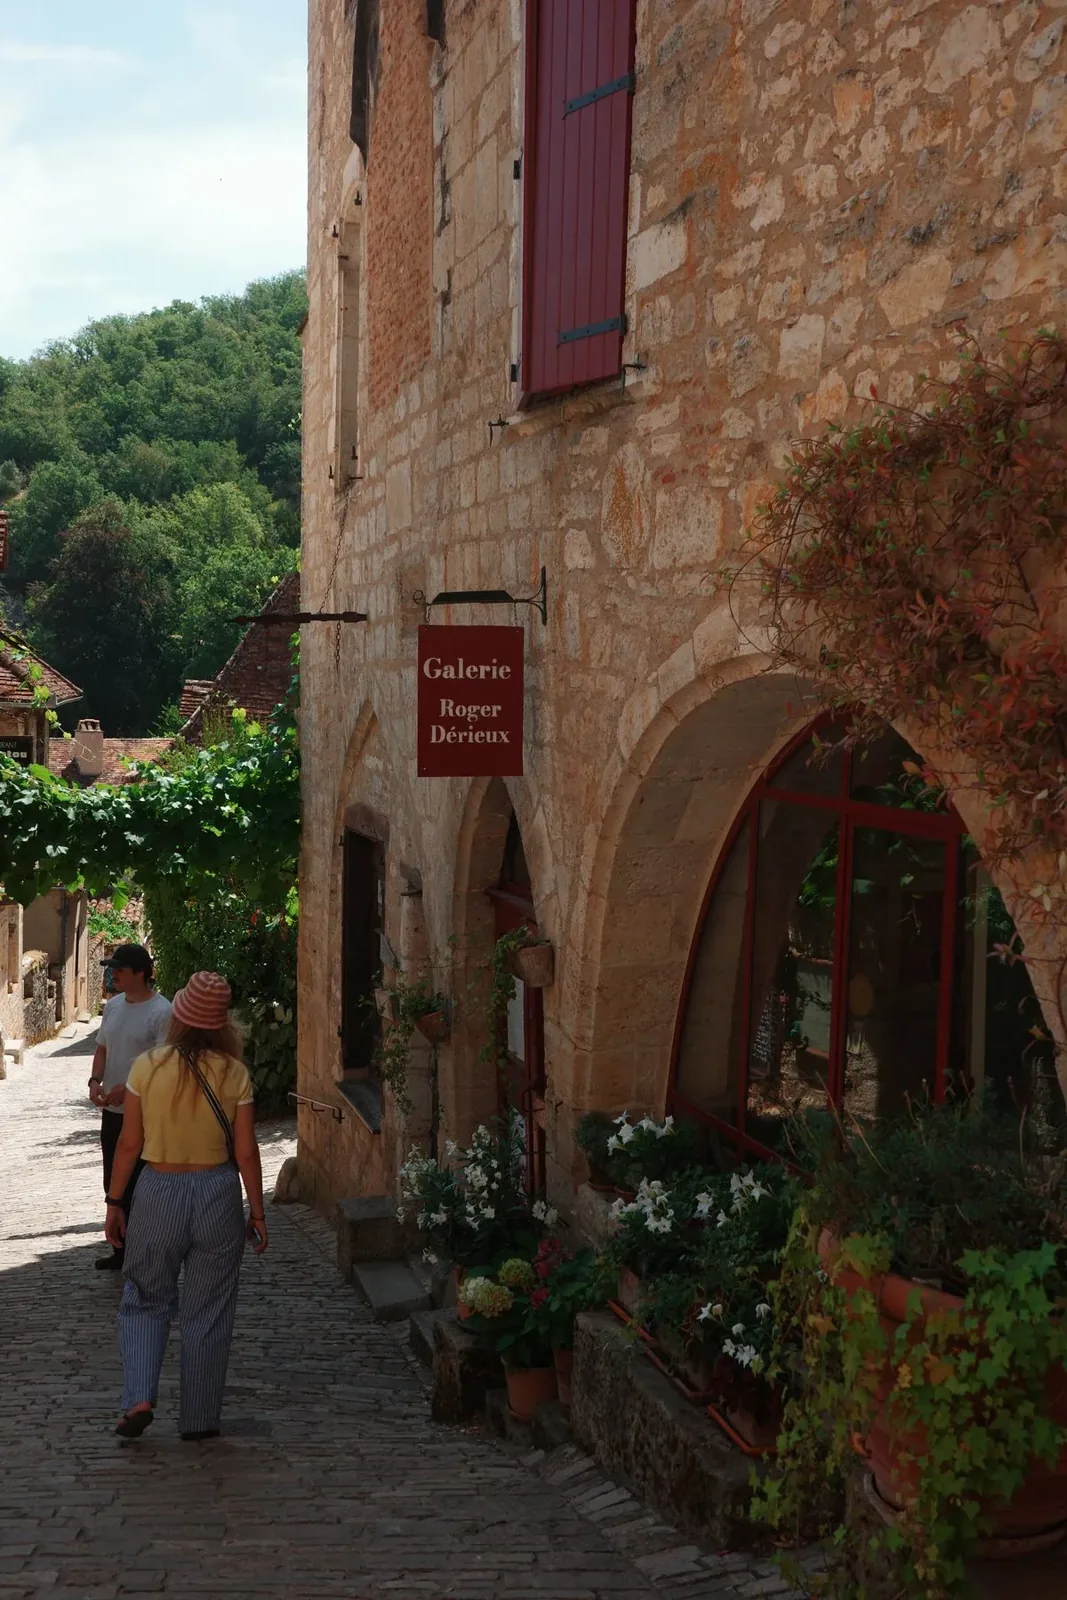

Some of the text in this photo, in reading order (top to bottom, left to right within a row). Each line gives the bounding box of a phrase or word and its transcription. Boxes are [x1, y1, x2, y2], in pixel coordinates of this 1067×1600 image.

[423, 657, 511, 680] Galerie
[439, 698, 502, 723] Roger
[430, 725, 510, 743] Dérieux
